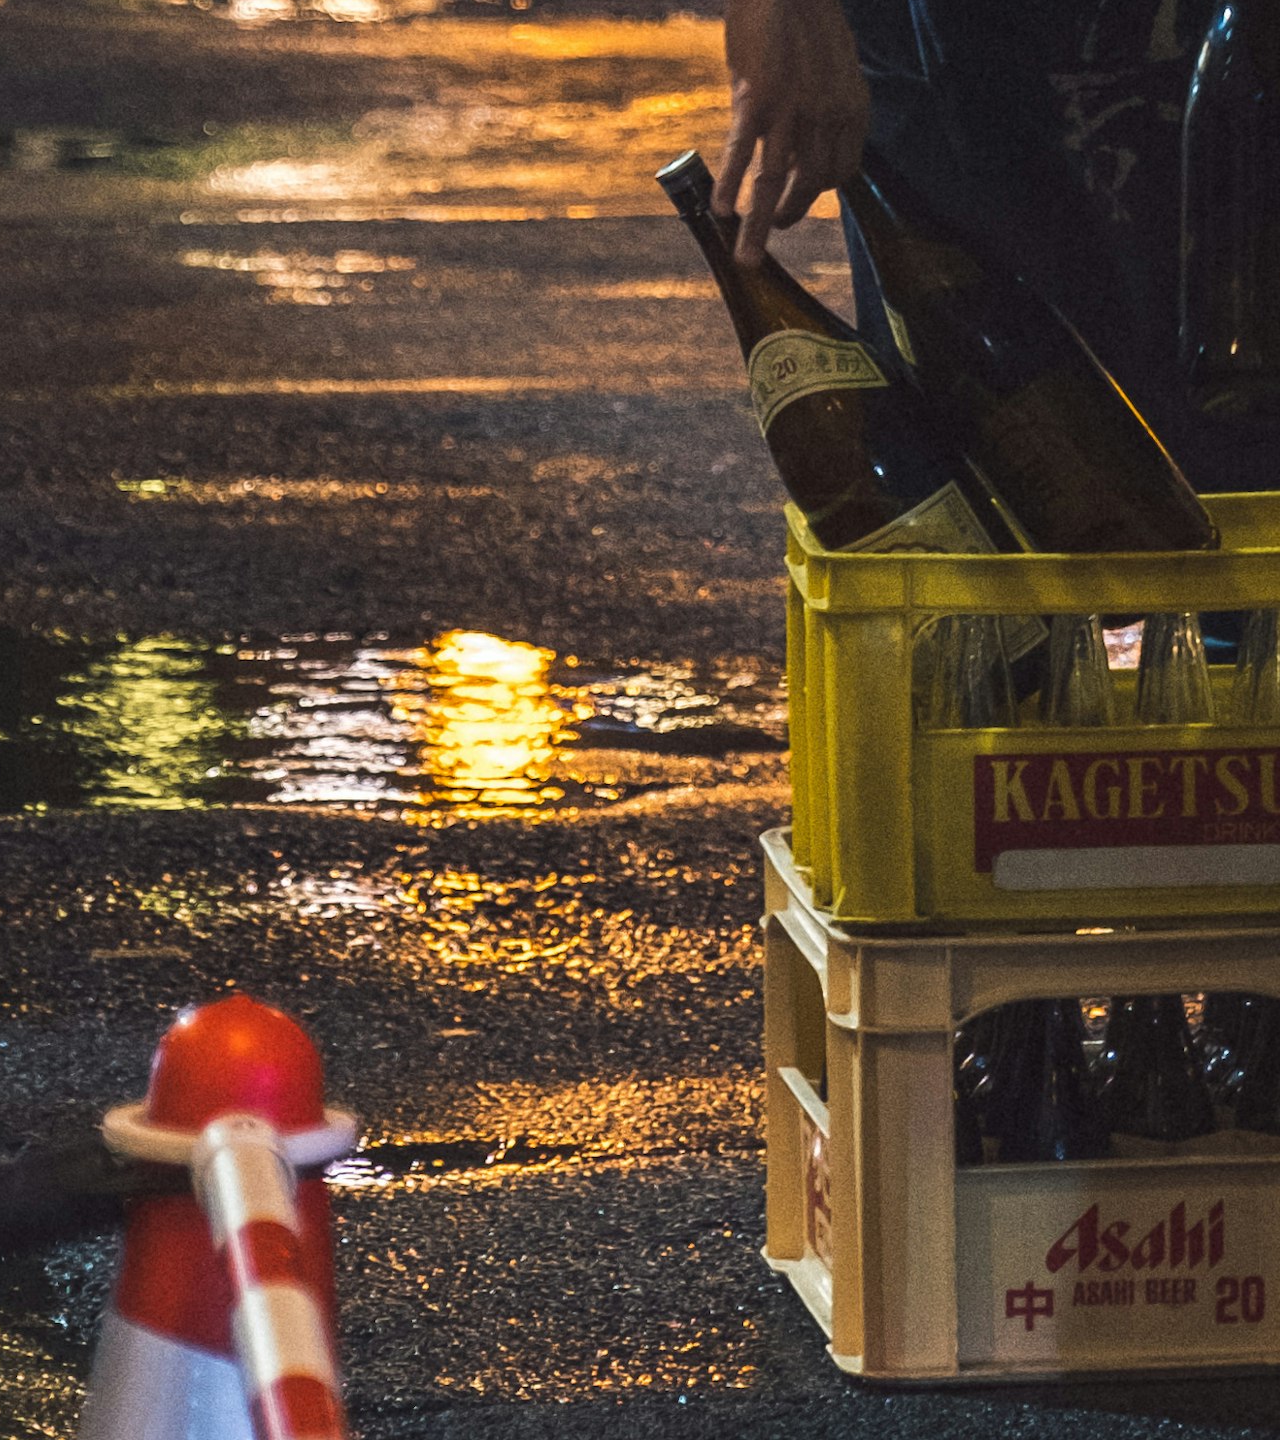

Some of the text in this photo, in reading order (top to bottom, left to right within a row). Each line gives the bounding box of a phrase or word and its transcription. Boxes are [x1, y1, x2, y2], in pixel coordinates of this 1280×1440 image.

[1045, 1200, 1224, 1274] Asahi
[1006, 1281, 1054, 1331] 中
[1073, 1280, 1135, 1307] ASAHI
[1216, 1276, 1265, 1324] 20
